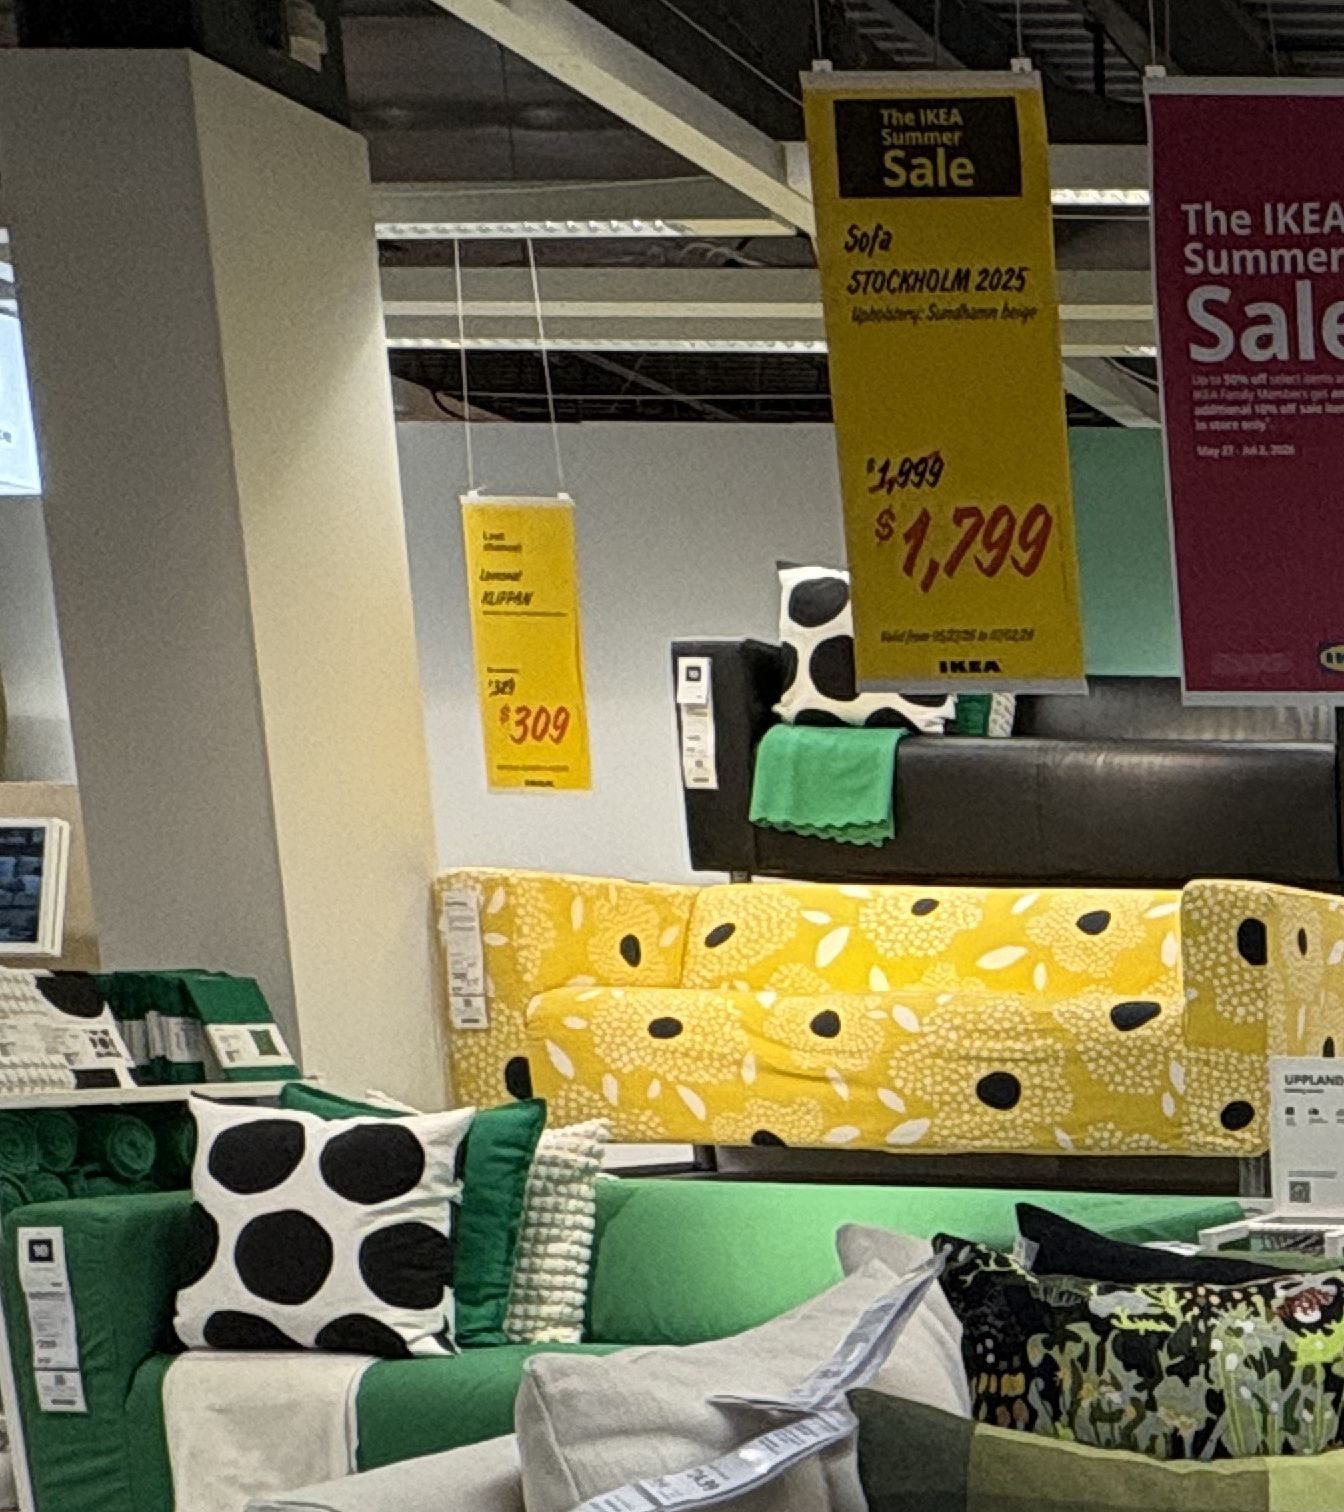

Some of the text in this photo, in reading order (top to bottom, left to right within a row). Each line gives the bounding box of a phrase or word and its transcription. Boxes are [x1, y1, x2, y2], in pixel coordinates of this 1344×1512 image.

[879, 108, 964, 126] The IKEA
[881, 128, 963, 146] Summer
[883, 147, 976, 188] Sale
[1181, 201, 1251, 236] The
[844, 223, 893, 257] Sofa
[848, 266, 1031, 295] STOCKHOLM 2025
[866, 453, 945, 495] $1,999
[875, 503, 1053, 593] $1,799
[939, 661, 1002, 674] IKEA
[500, 704, 570, 745] $309
